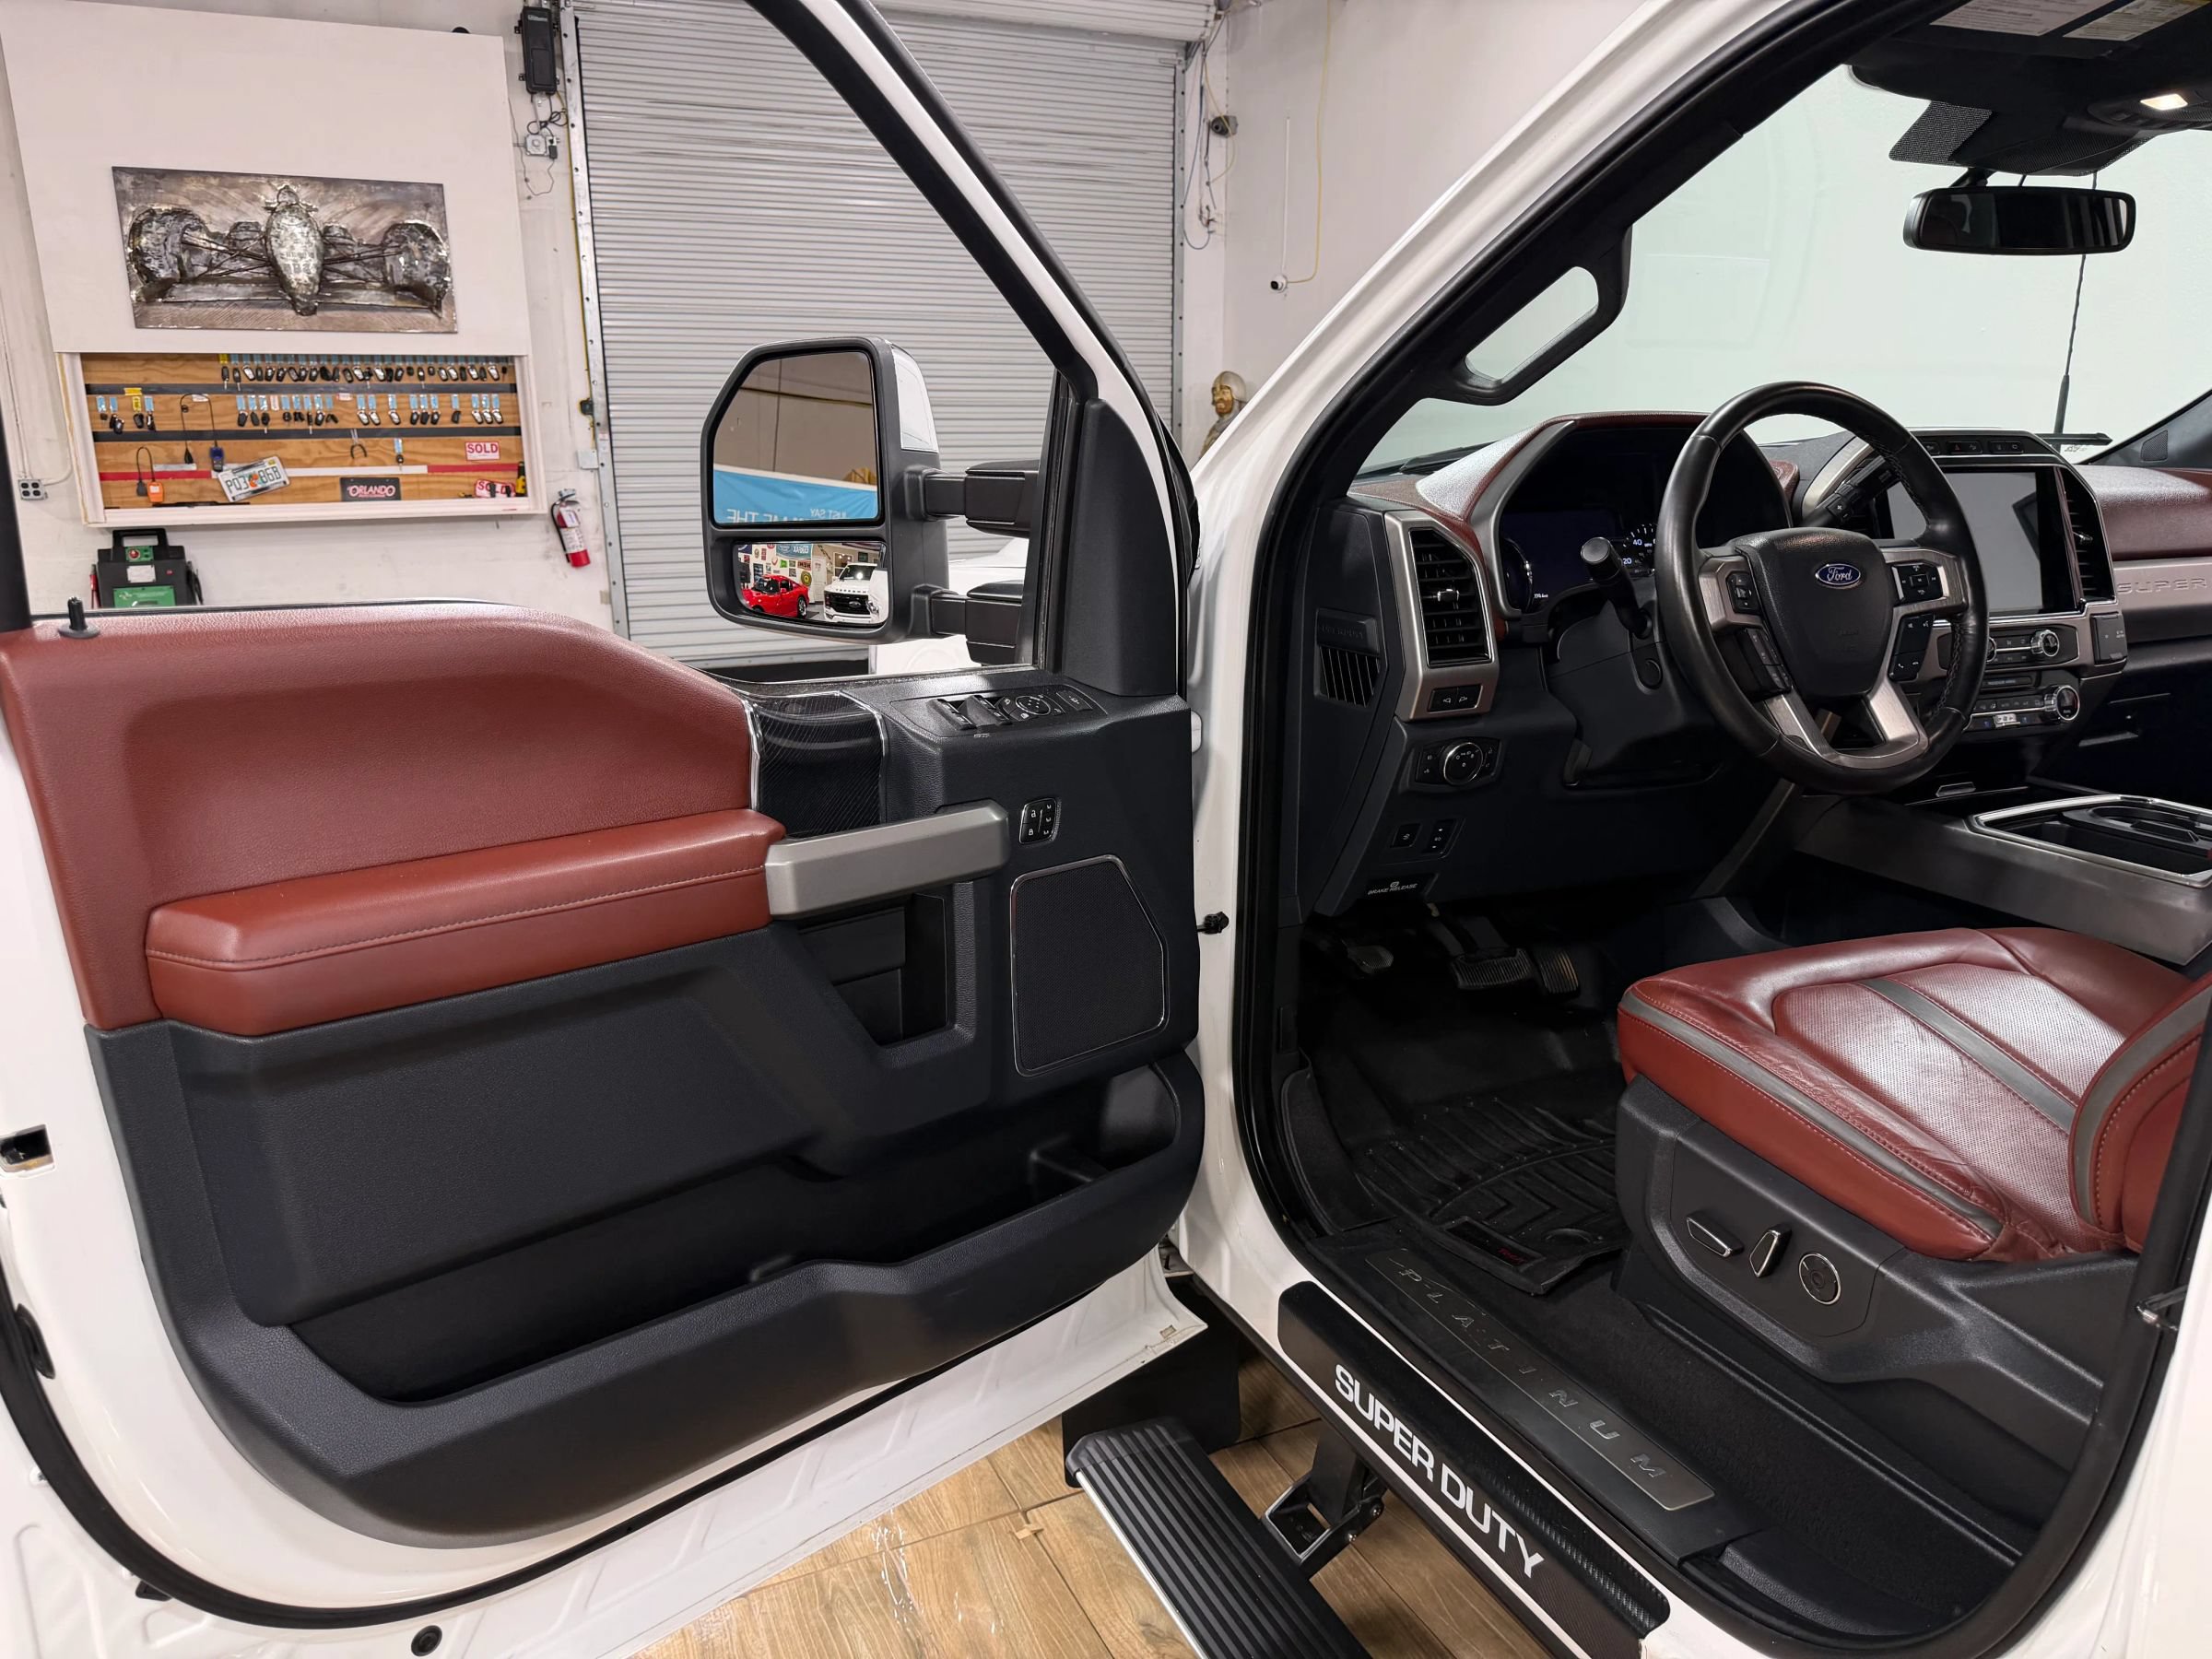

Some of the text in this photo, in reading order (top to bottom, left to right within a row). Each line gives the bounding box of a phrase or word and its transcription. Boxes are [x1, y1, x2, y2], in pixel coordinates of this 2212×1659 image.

[467, 443, 498, 453] SOLD
[348, 485, 396, 497] ORLANDO
[1827, 566, 1853, 581] Ford
[2117, 578, 2207, 594] SUPER
[1398, 1268, 1666, 1478] PLATINUM
[1335, 1364, 1545, 1579] SUPER DUTY
